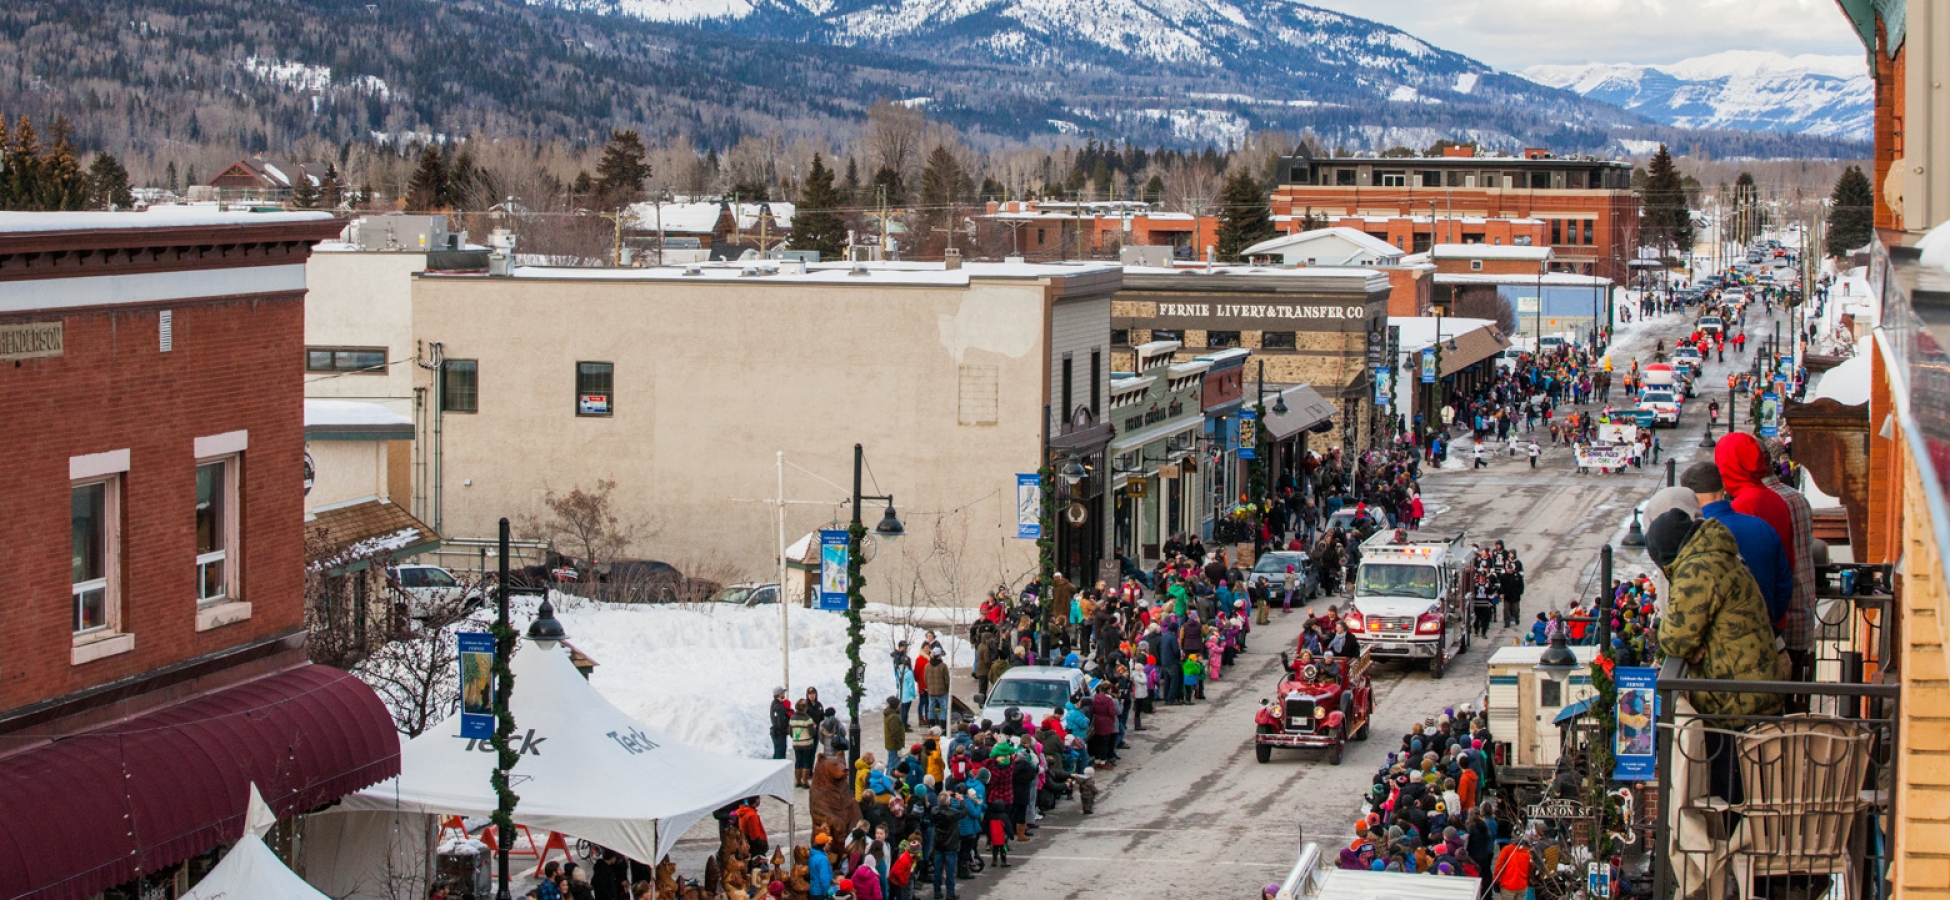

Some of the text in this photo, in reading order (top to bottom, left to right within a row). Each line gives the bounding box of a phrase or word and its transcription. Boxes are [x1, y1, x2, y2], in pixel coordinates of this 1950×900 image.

[1160, 303, 1210, 317] FERNIE
[1346, 306, 1364, 319] CO
[1, 327, 61, 353] HENDERSON
[605, 725, 661, 755] Teck
